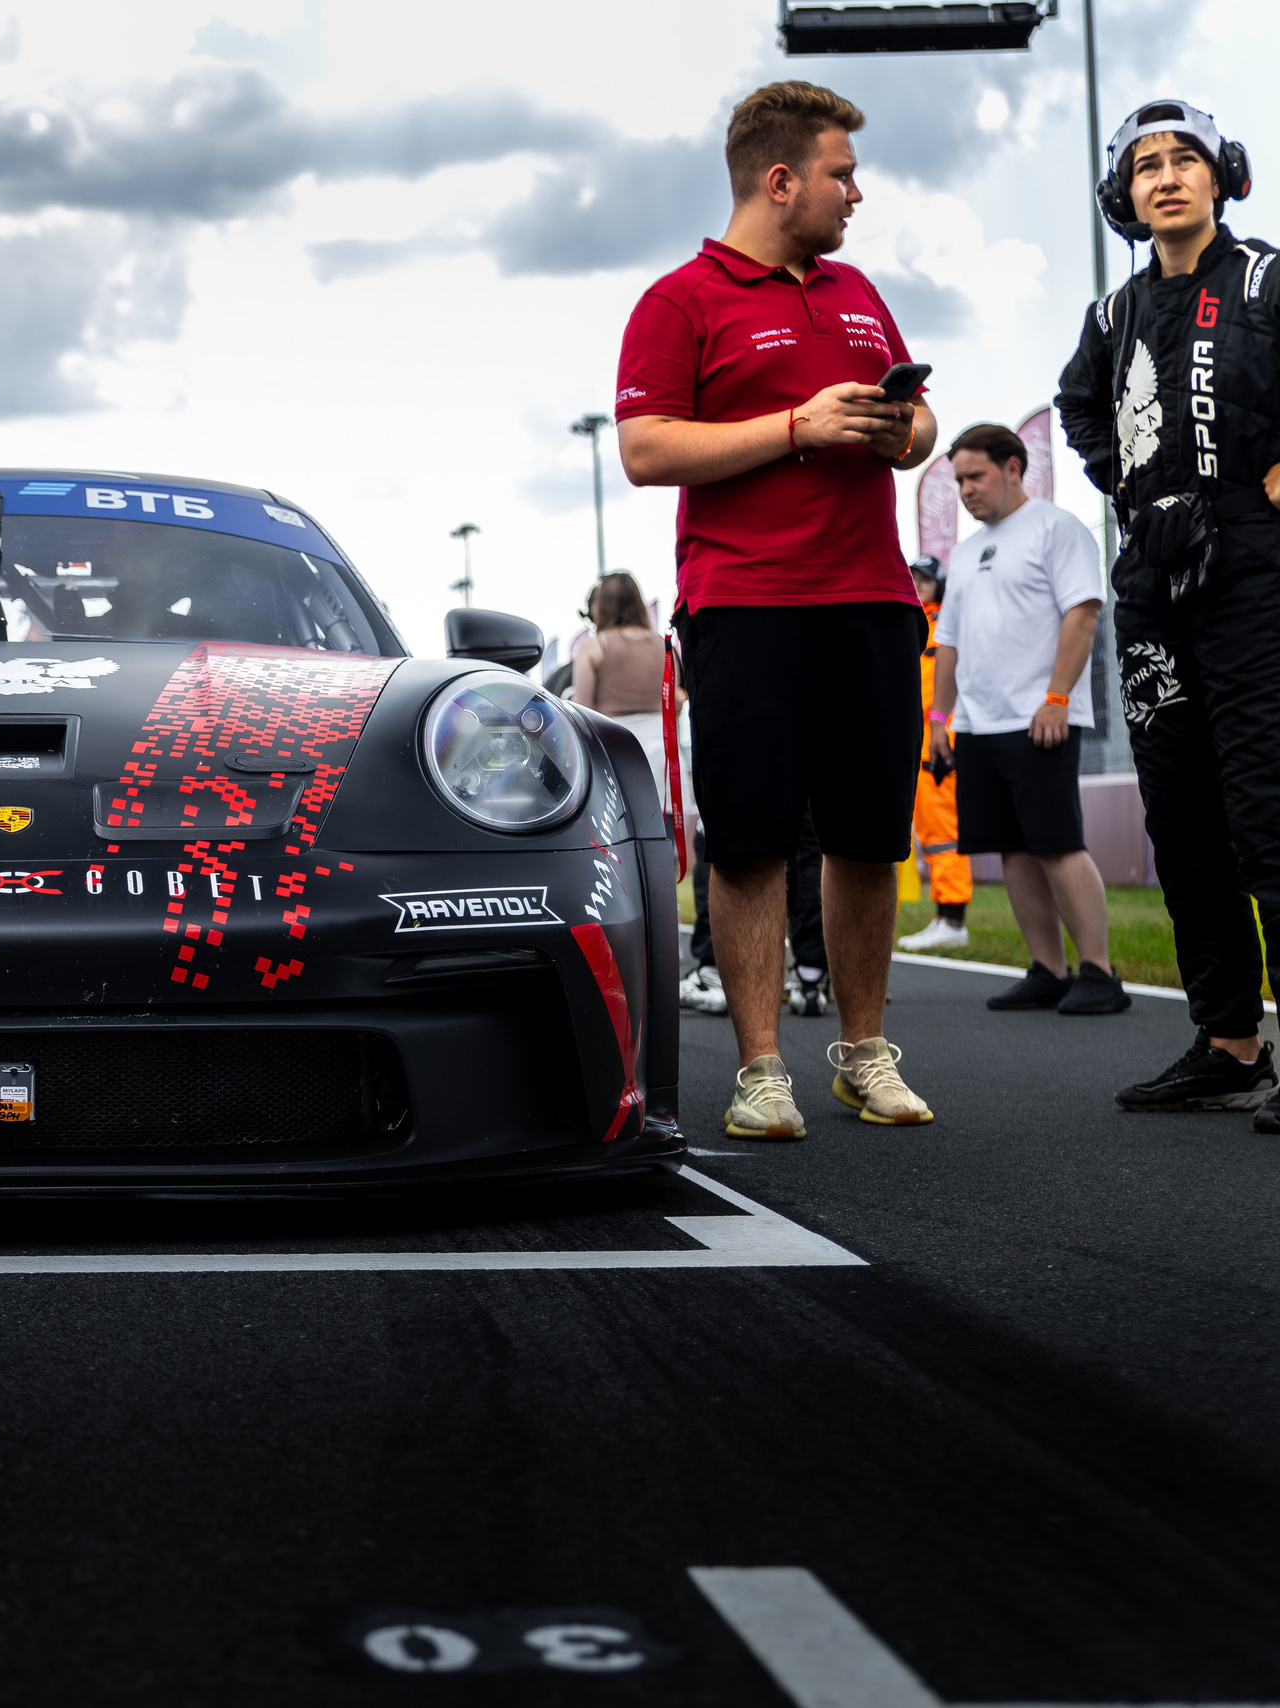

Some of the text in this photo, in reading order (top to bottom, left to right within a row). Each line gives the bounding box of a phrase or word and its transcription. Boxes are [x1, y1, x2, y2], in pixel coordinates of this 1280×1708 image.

[1191, 288, 1220, 478] SPORA GT
[85, 487, 215, 520] ВТБ
